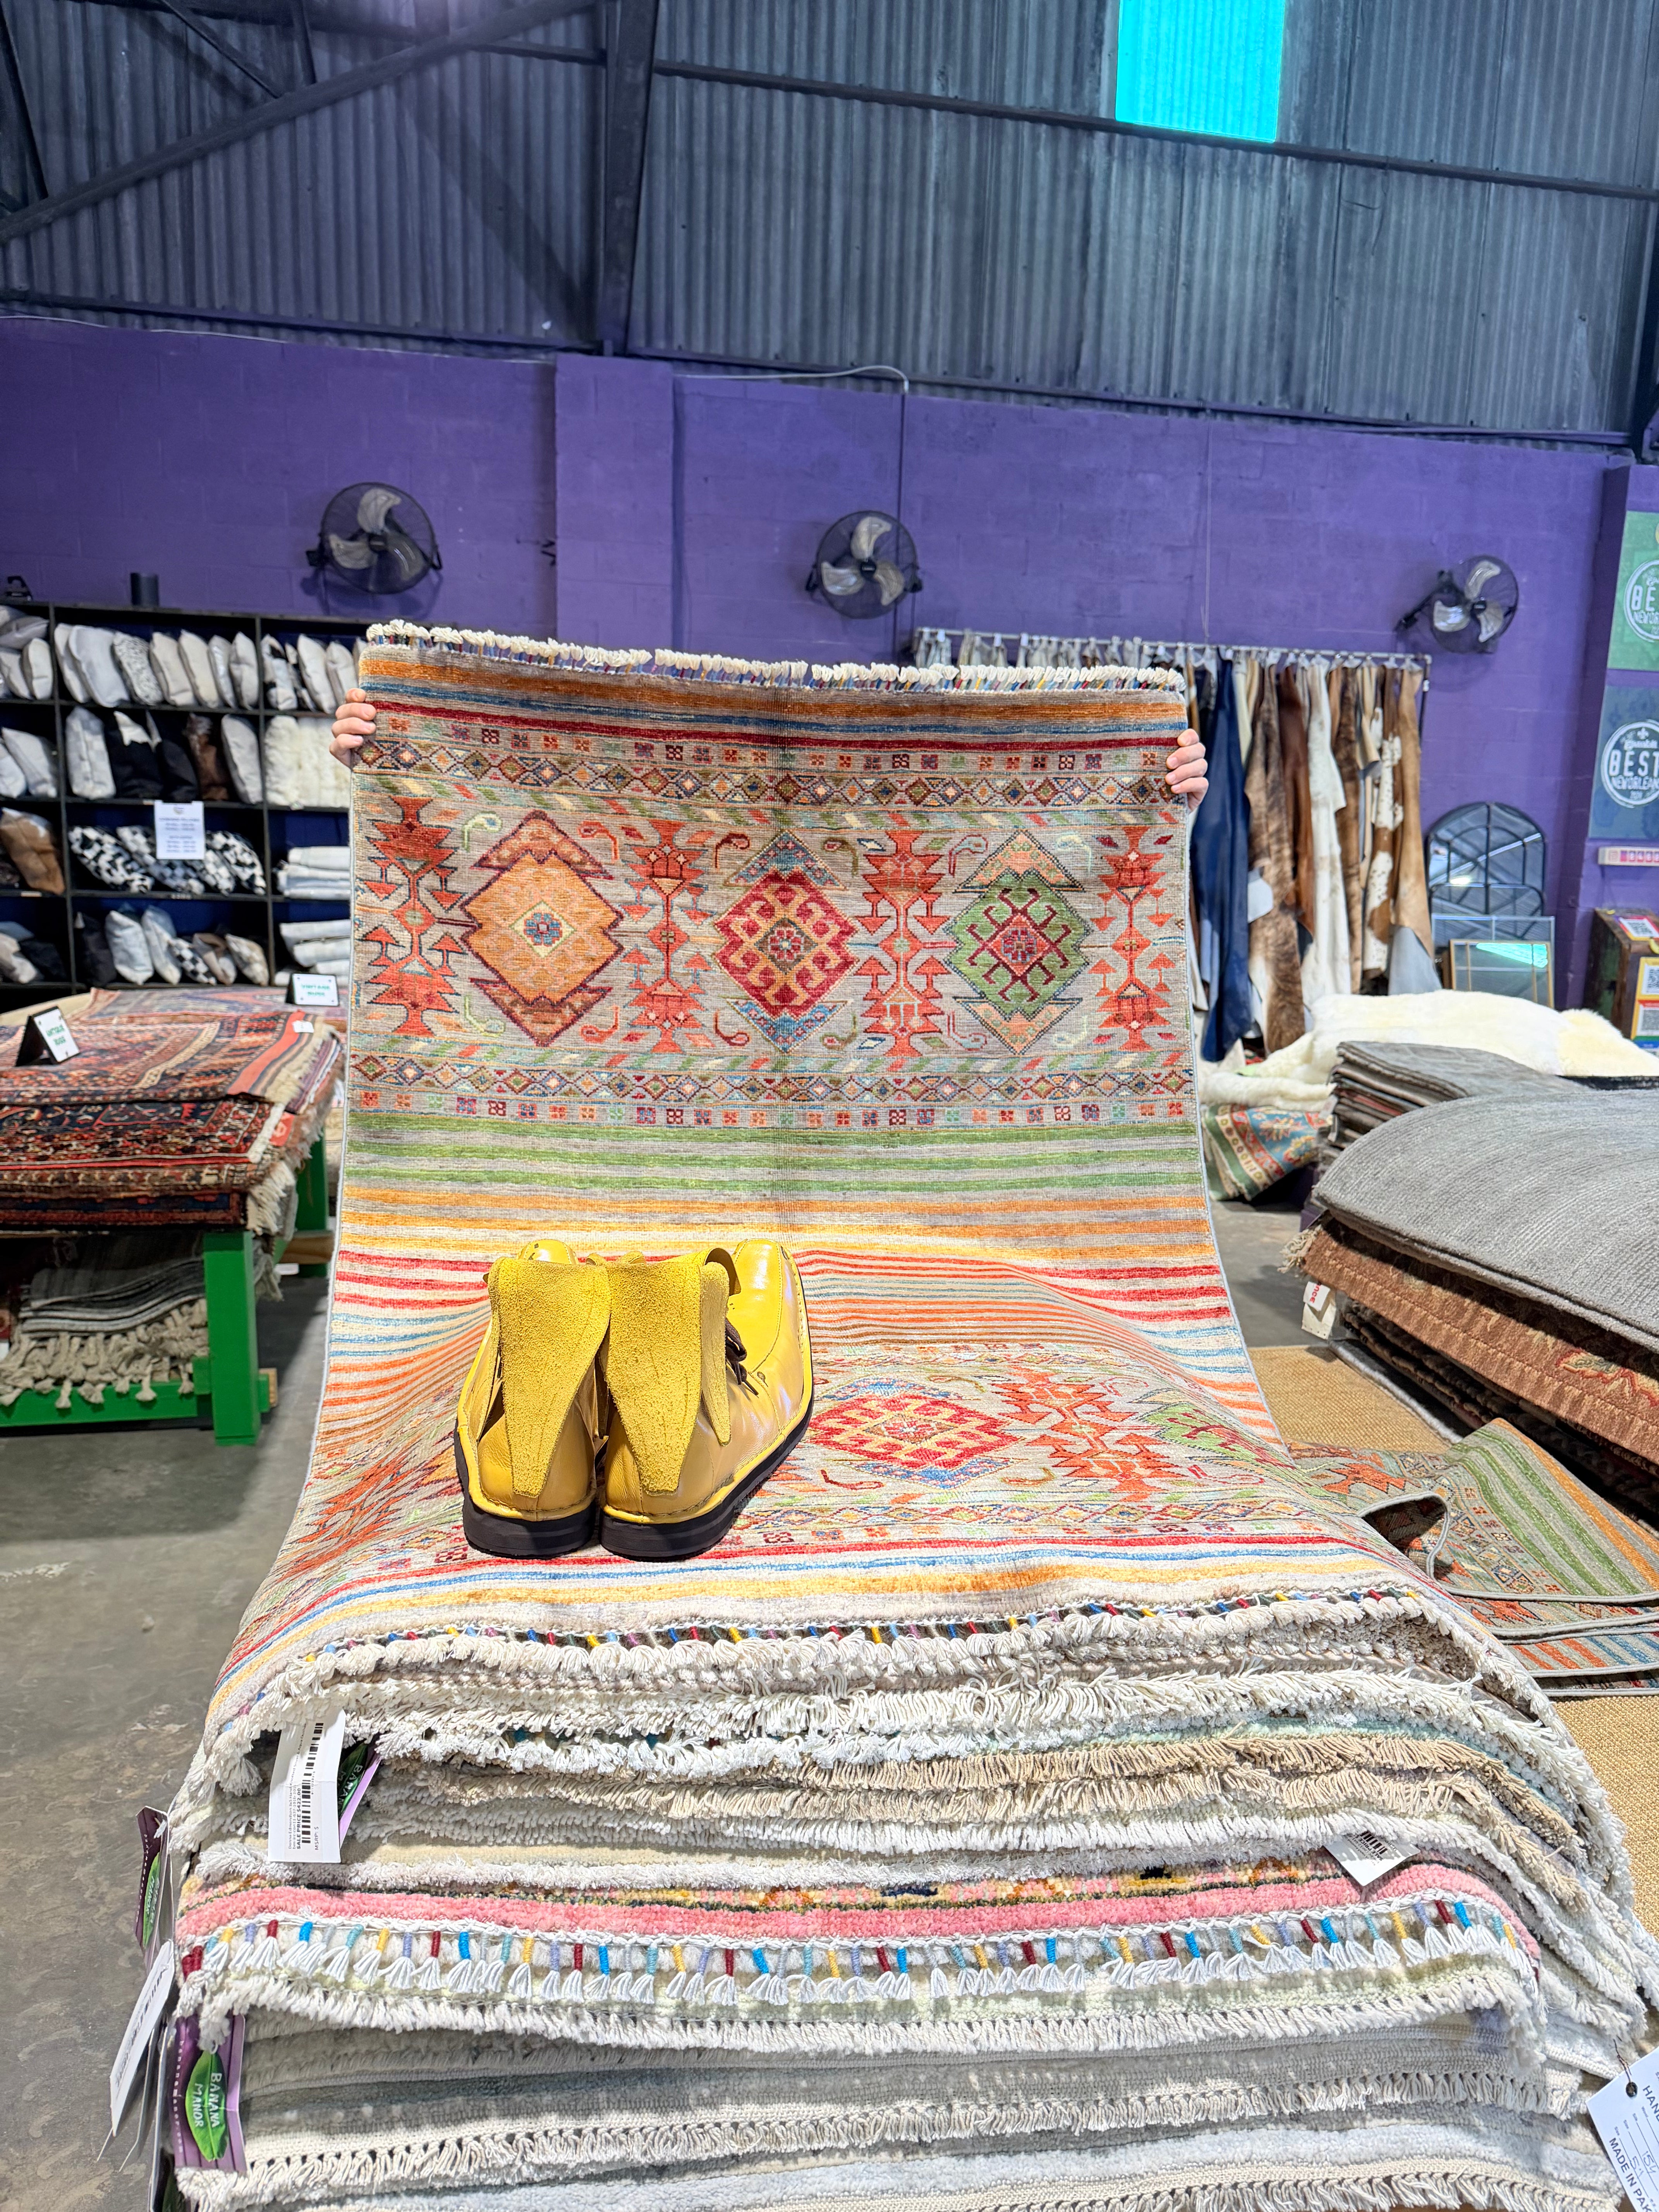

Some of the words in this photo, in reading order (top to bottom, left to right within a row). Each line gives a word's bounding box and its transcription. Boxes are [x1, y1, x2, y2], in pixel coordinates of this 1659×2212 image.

[1609, 749, 1659, 778] BEST
[1358, 1838, 1372, 1851] PRICE
[1371, 1850, 1384, 1861] SALE
[192, 2083, 204, 2128] MANOR
[208, 2072, 222, 2128] BANANA
[1609, 2138, 1630, 2173] MADE
[1626, 2173, 1637, 2187] IN
